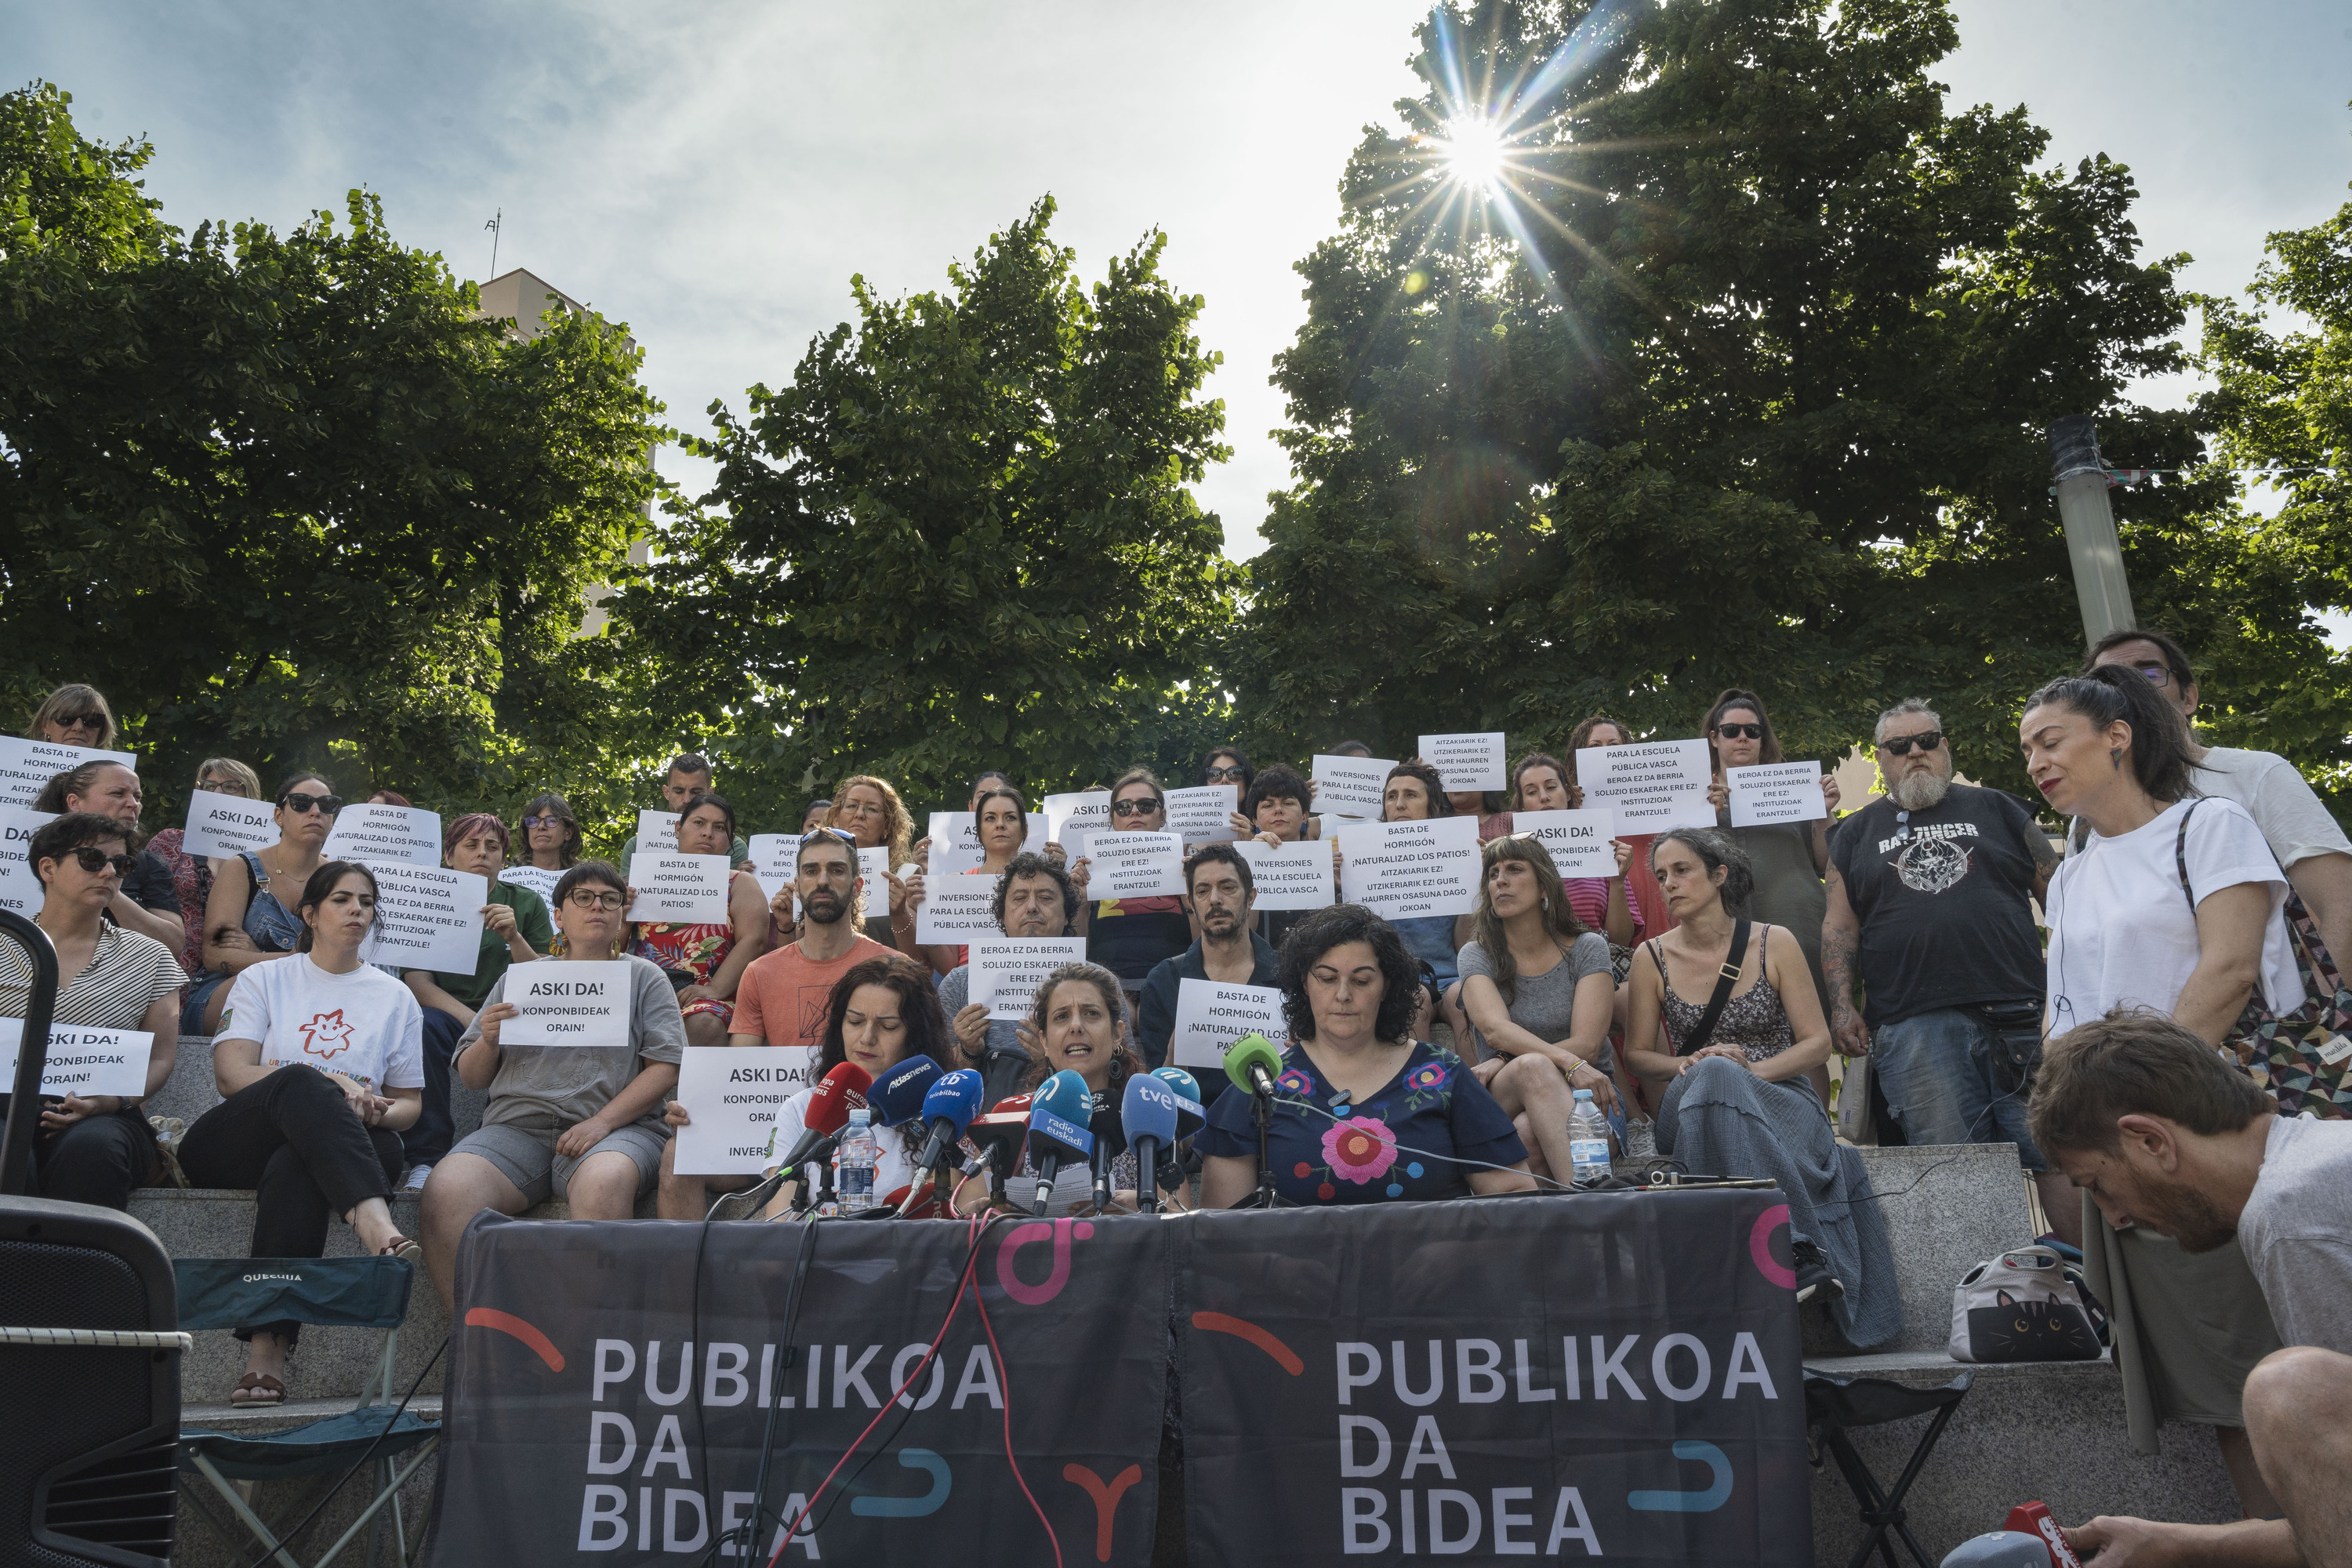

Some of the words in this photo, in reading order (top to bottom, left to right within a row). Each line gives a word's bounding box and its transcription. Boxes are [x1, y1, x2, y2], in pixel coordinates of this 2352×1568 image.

[32, 746, 64, 757] BASTA
[1642, 746, 1681, 756] ESCUELA
[1612, 762, 1648, 771] PÚBLICA
[1649, 760, 1678, 768] VASCA
[1330, 771, 1381, 782] INVERSIONES
[1773, 779, 1811, 787] ESKAERAK
[1595, 788, 1628, 797] SOLUZIO
[1629, 785, 1668, 794] ESKAERAK
[1325, 793, 1356, 802] PÚBLICA
[1358, 797, 1382, 805] VASCA
[1621, 796, 1673, 806] INSTITUZIOAK
[1752, 799, 1802, 808] INSTITUZIOAK
[369, 809, 394, 818] BASTA
[1073, 805, 1098, 815] ASKI
[1625, 808, 1671, 818] ERANTZULE!
[1756, 809, 1801, 818] ERANTZULE!
[209, 809, 241, 823] ASKI
[244, 815, 268, 828] DA!
[362, 821, 411, 833] HORMIGÓN
[1388, 826, 1415, 835] BASTA
[1537, 827, 1566, 839] ASKI
[1570, 826, 1594, 838] DA!
[201, 826, 270, 844] KONPONBIDEAK
[333, 833, 388, 843] ¡NATURALIZAD
[390, 837, 407, 845] LOS
[408, 839, 435, 848] PATIOS!
[218, 841, 247, 852] ORAIN!
[1094, 837, 1120, 846] BEROA
[1385, 837, 1435, 849] HORMIGÓN
[352, 845, 399, 856] AITZAKIARIK
[1097, 849, 1131, 858] SOLUZIO
[1132, 846, 1172, 855] ESKAERAK
[1352, 855, 1415, 867] ¡NATURALIZAD
[1436, 850, 1470, 858] PATIOS!
[372, 866, 398, 877] PARA
[400, 869, 412, 878] LA
[414, 871, 458, 884] ESCUELA
[654, 873, 704, 882] HORMIGÓN
[1109, 869, 1163, 879] INSTITUZIOAK
[1381, 867, 1429, 877] AITZAKIARIK
[1113, 881, 1160, 891] ERANTZULE!
[1367, 880, 1421, 891] UTZIKERIARIK
[419, 887, 451, 898] VASCA
[637, 887, 700, 896] ¡NATURALIZAD
[1362, 894, 1400, 903] HAURREN
[1402, 891, 1442, 900] OSASUNA
[1443, 888, 1467, 897] DAGO
[423, 902, 455, 913] BERRIA
[1399, 904, 1431, 913] JOKOAN
[388, 911, 434, 924] ESKAERAK
[934, 920, 971, 929] PÚBLICA
[530, 982, 570, 996] ASKI
[575, 982, 604, 996] DA!
[1217, 991, 1250, 1001] BASTA
[1252, 995, 1267, 1004] DE
[522, 1007, 611, 1015] KONPONBIDEAK
[1209, 1007, 1270, 1020] HORMIGÓN
[546, 1023, 585, 1032] ORAIN!
[82, 1034, 119, 1045] DA!
[1267, 1029, 1288, 1040] LOS
[2325, 1042, 2348, 1058] matilda
[42, 1073, 91, 1084] ORAIN!
[729, 1068, 771, 1083] ASKI
[775, 1068, 805, 1082] DA!
[929, 1089, 960, 1099] telebilbao
[1139, 1087, 1173, 1111] tve
[1048, 1117, 1074, 1134] radio
[1047, 1126, 1083, 1148] euskadi
[592, 1338, 1005, 1410] PUBLIKOA
[1336, 1332, 1777, 1406] PUBLIKOA
[586, 1411, 692, 1479] DA
[1339, 1414, 1457, 1479] DA
[576, 1483, 821, 1560] BIDEA
[1342, 1486, 1603, 1556] BIDEA
